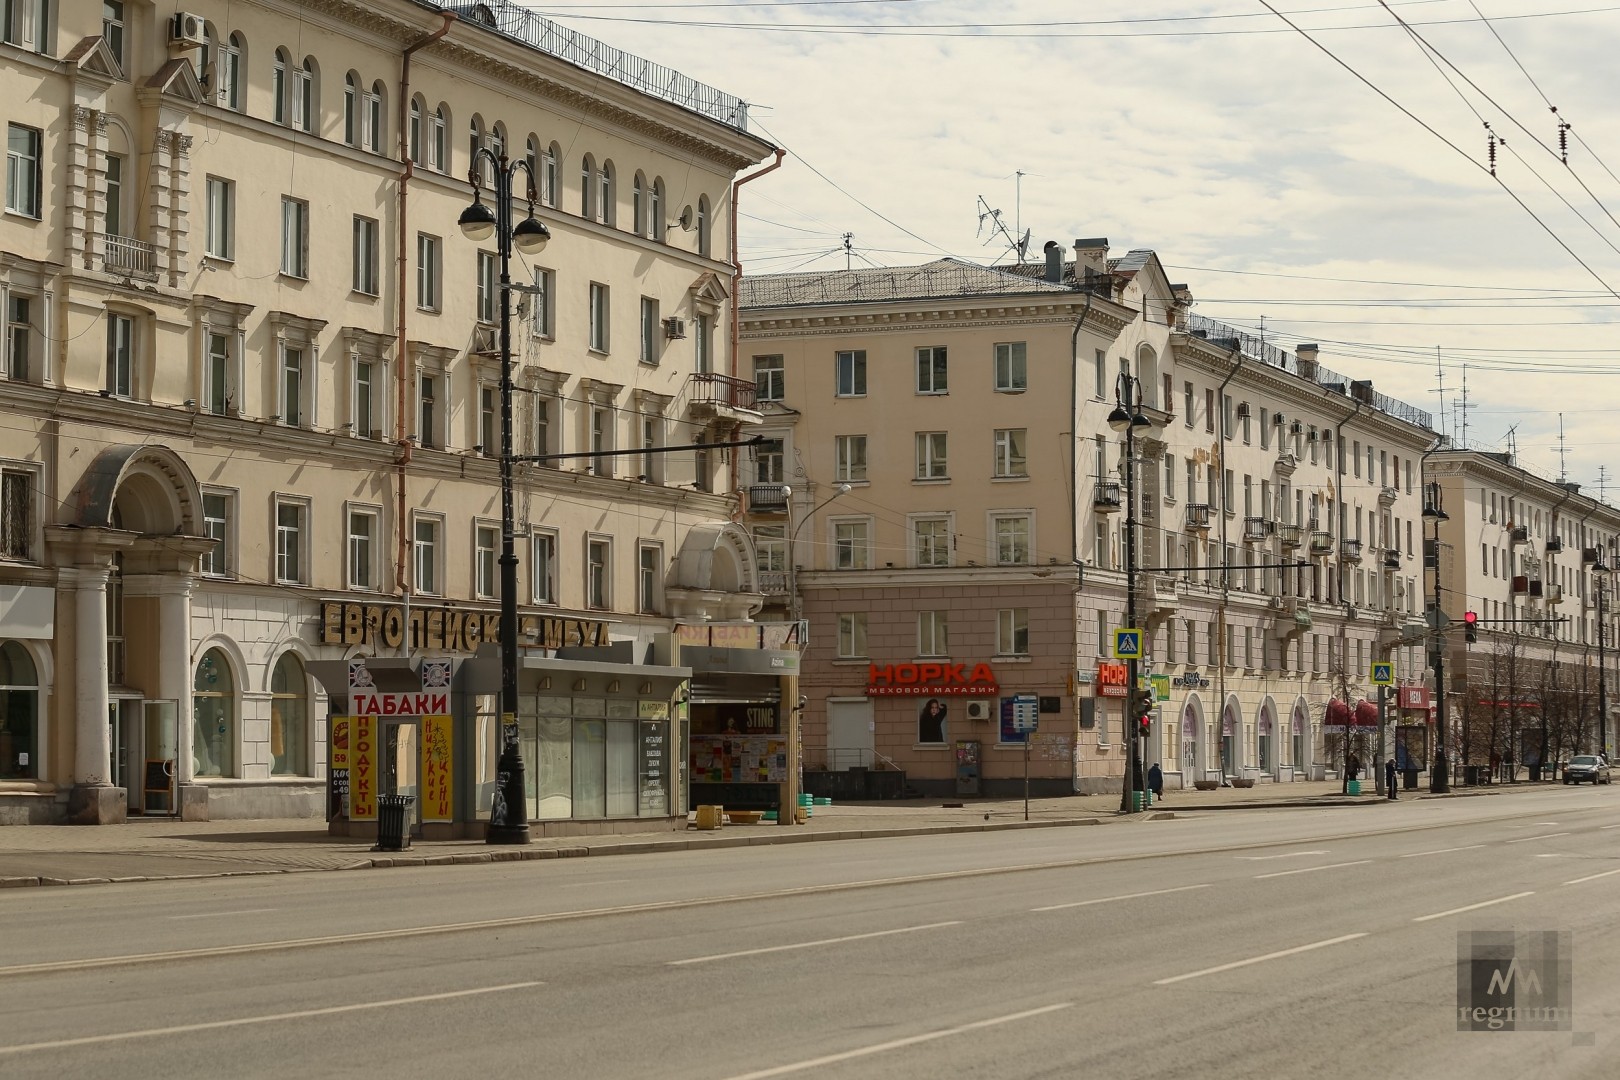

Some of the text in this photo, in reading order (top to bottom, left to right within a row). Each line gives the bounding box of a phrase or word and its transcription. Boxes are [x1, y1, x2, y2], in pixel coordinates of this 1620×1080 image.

[541, 617, 612, 648] МЕХА
[869, 662, 997, 684] НОРКА
[354, 693, 447, 715] ТАБАКИ
[747, 707, 774, 728] STING
[355, 716, 372, 815] ПРОДУКТЫ
